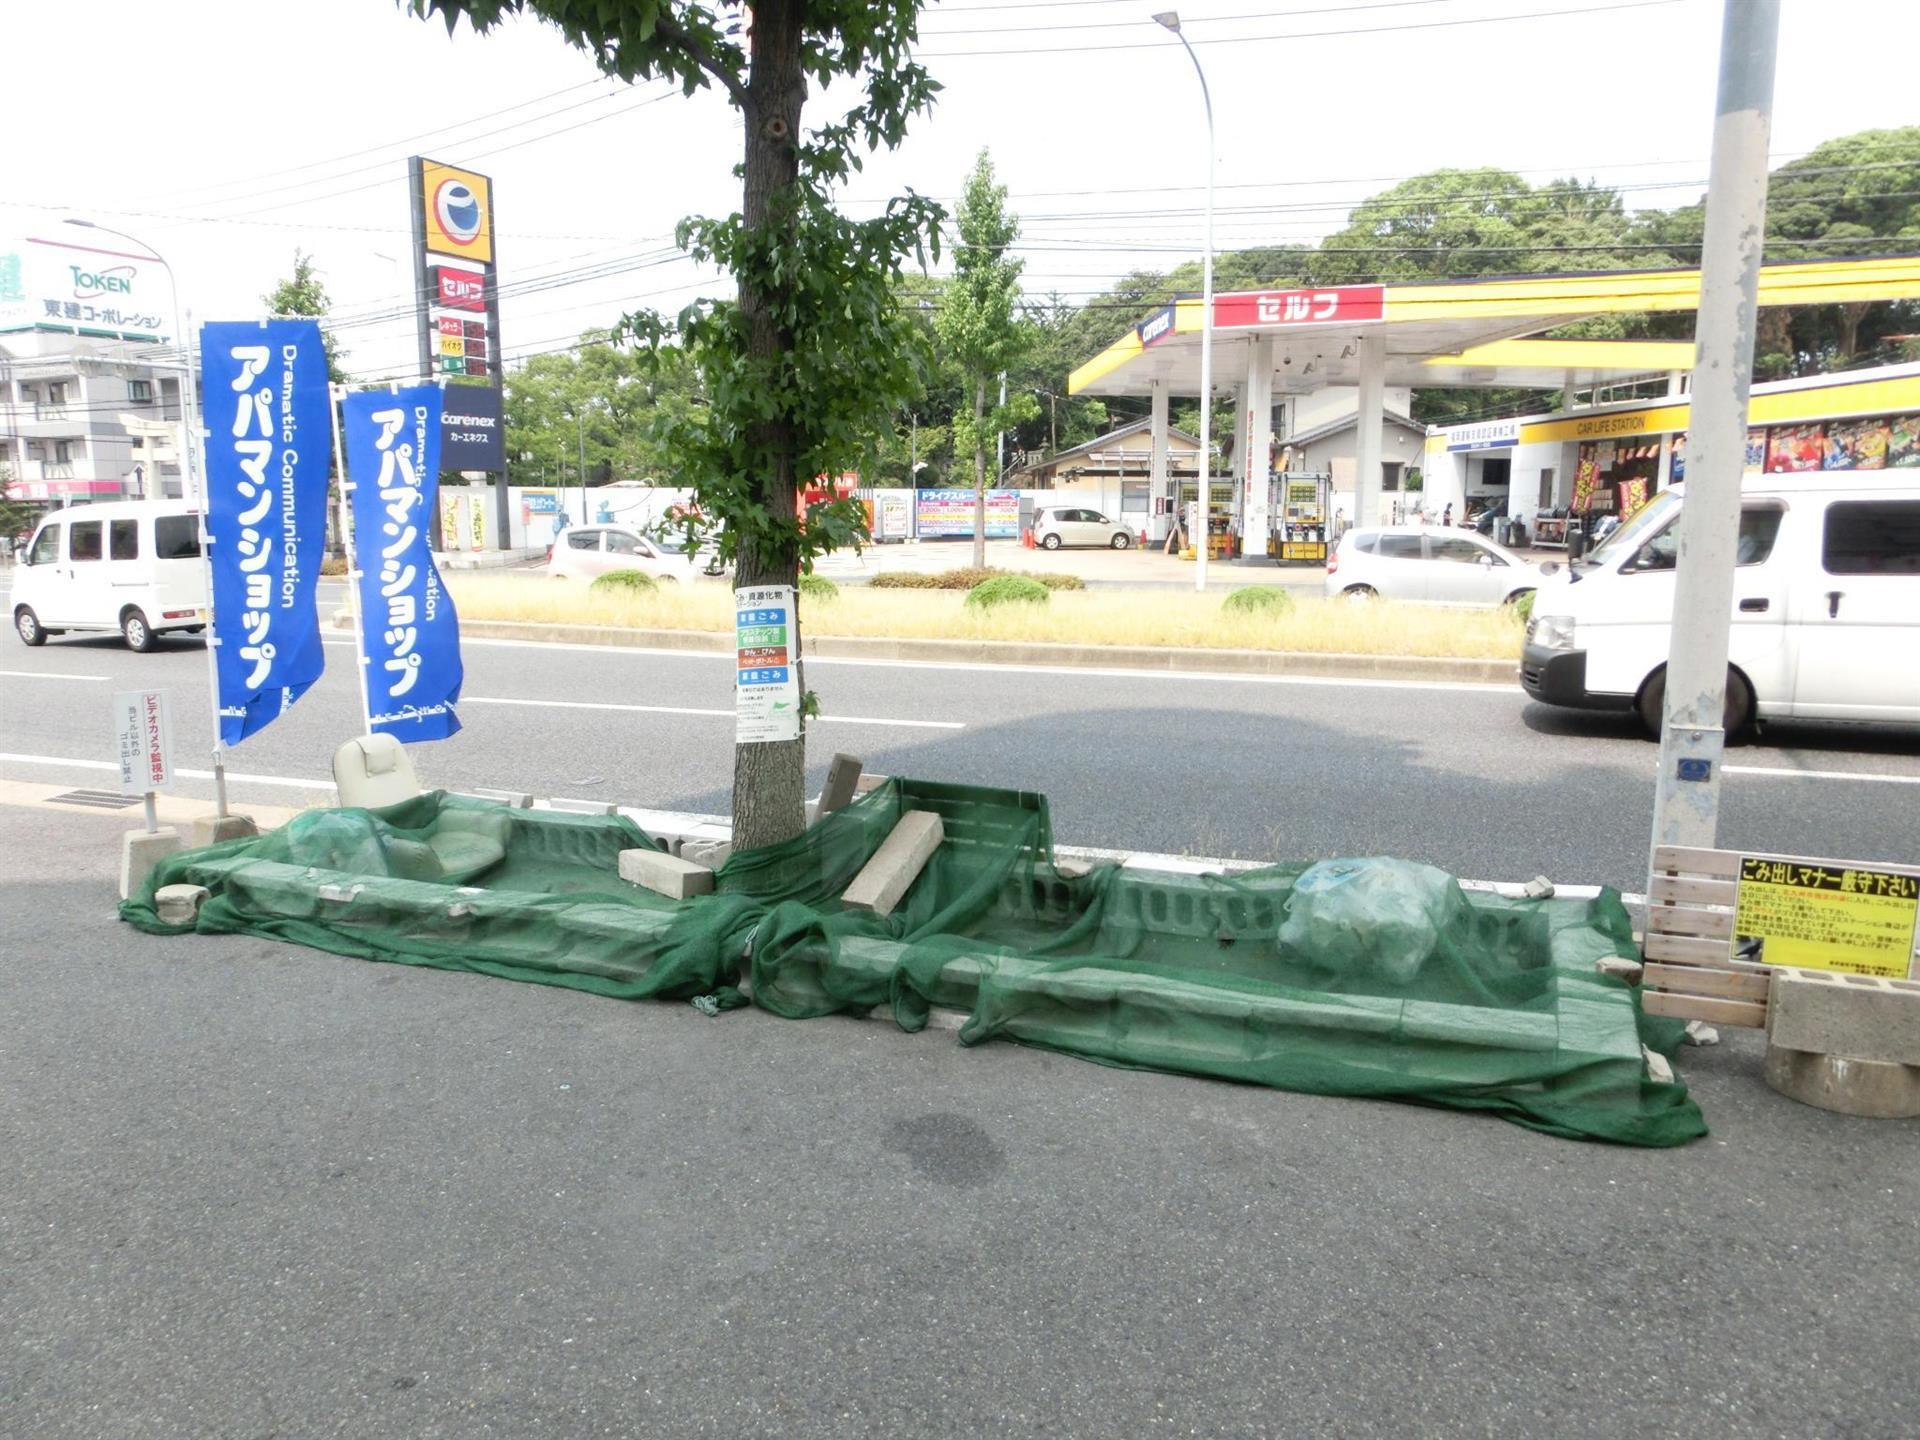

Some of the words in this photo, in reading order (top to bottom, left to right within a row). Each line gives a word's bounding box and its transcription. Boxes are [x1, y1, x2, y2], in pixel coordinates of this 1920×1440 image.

[70, 265, 131, 294] TOKEN
[442, 277, 482, 299] セルフ
[43, 299, 161, 328] 東建コーポレーション
[1256, 293, 1338, 322] セルフ
[281, 345, 297, 443] Dramatic
[441, 412, 495, 427] carenex
[1577, 421, 1594, 434] CAR
[1596, 419, 1610, 432] LIFE
[1611, 416, 1646, 430] STATION
[415, 406, 427, 487] Dramatic
[450, 432, 489, 443] カーエネクス
[231, 346, 276, 689] アパマンショップ
[281, 449, 299, 608] Communication
[371, 408, 422, 697] アパマンショップ
[146, 695, 163, 783] ビデオカメラ監視中
[1743, 859, 1916, 898] ごみ出しマナー厳守下さい
